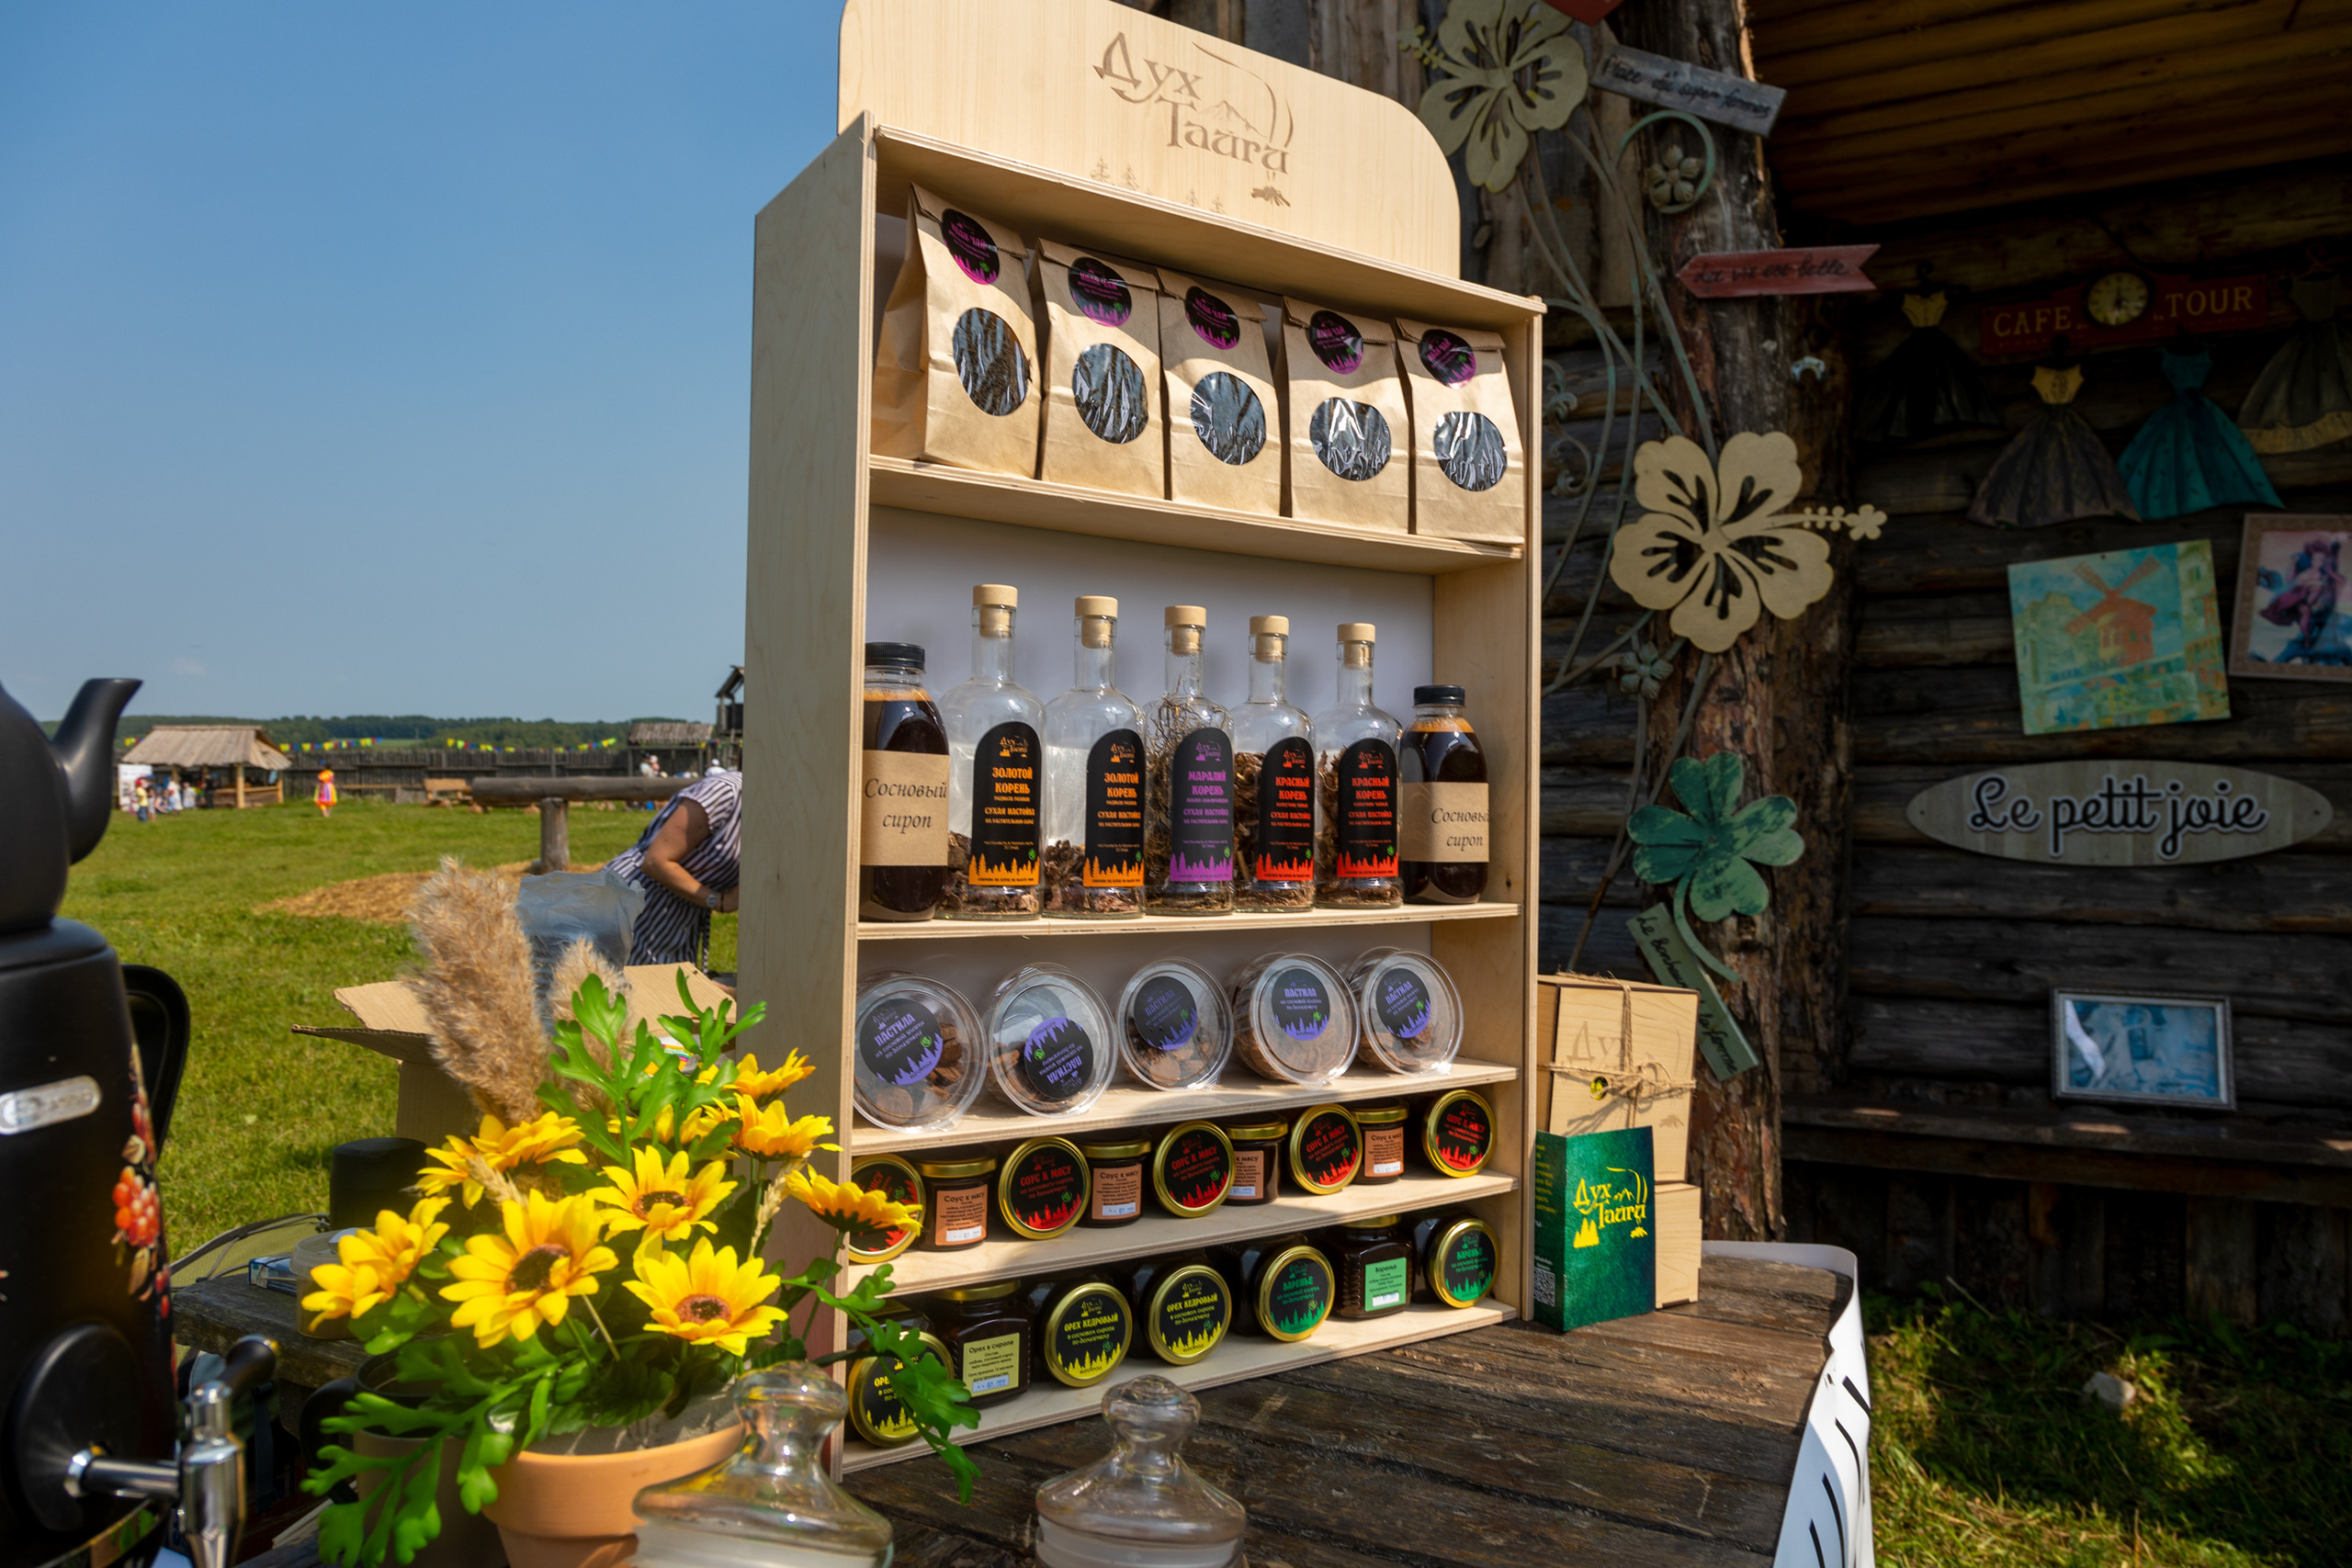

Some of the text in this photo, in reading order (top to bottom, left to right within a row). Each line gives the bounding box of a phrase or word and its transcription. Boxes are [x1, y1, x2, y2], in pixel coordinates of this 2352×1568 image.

[1092, 31, 1203, 104] Дух
[1154, 95, 1290, 175] Тайги
[1993, 306, 2072, 337] CAFE
[2165, 286, 2255, 318] TOUR
[992, 766, 1033, 780] ЗОЛОТОЙ
[1103, 772, 1139, 784] ЗОЛОТОЙ
[865, 777, 947, 798] Сосновый
[994, 782, 1031, 795] КОРЕНЬ
[1106, 786, 1137, 798] КОРЕНЬ
[1192, 784, 1224, 796] КОРЕНЬ
[1278, 790, 1307, 801] КОРЕНЬ
[1355, 790, 1387, 800] КОРЕНЬ
[882, 814, 932, 834] сироп
[1969, 774, 2267, 859] Le petit joie
[1446, 836, 1483, 852] сироп
[1144, 988, 1176, 1017] ПАСТИЛА
[1283, 987, 1317, 998] ПАСТИЛА
[1385, 980, 1413, 1006] ПАСТИЛА
[874, 1012, 917, 1047] ПАСТИЛА
[1046, 1055, 1083, 1085] ПАСТИЛА
[1170, 1145, 1217, 1170] СОУС К МЯСУ
[1020, 1165, 1071, 1187] СОУС К МЯСУ
[1100, 1171, 1119, 1179] Соус
[1572, 1178, 1612, 1215] Дух
[1590, 1199, 1647, 1229] Тайги
[1283, 1275, 1314, 1292] ВАРЕНЬЕ
[1166, 1292, 1218, 1313] ОРЕХ КЕДРОВЫЙ
[1064, 1312, 1119, 1332] ОРЕХ КЕДРОВЫЙ
[968, 1346, 986, 1354] Орех
[991, 1339, 1014, 1349] сиропе
